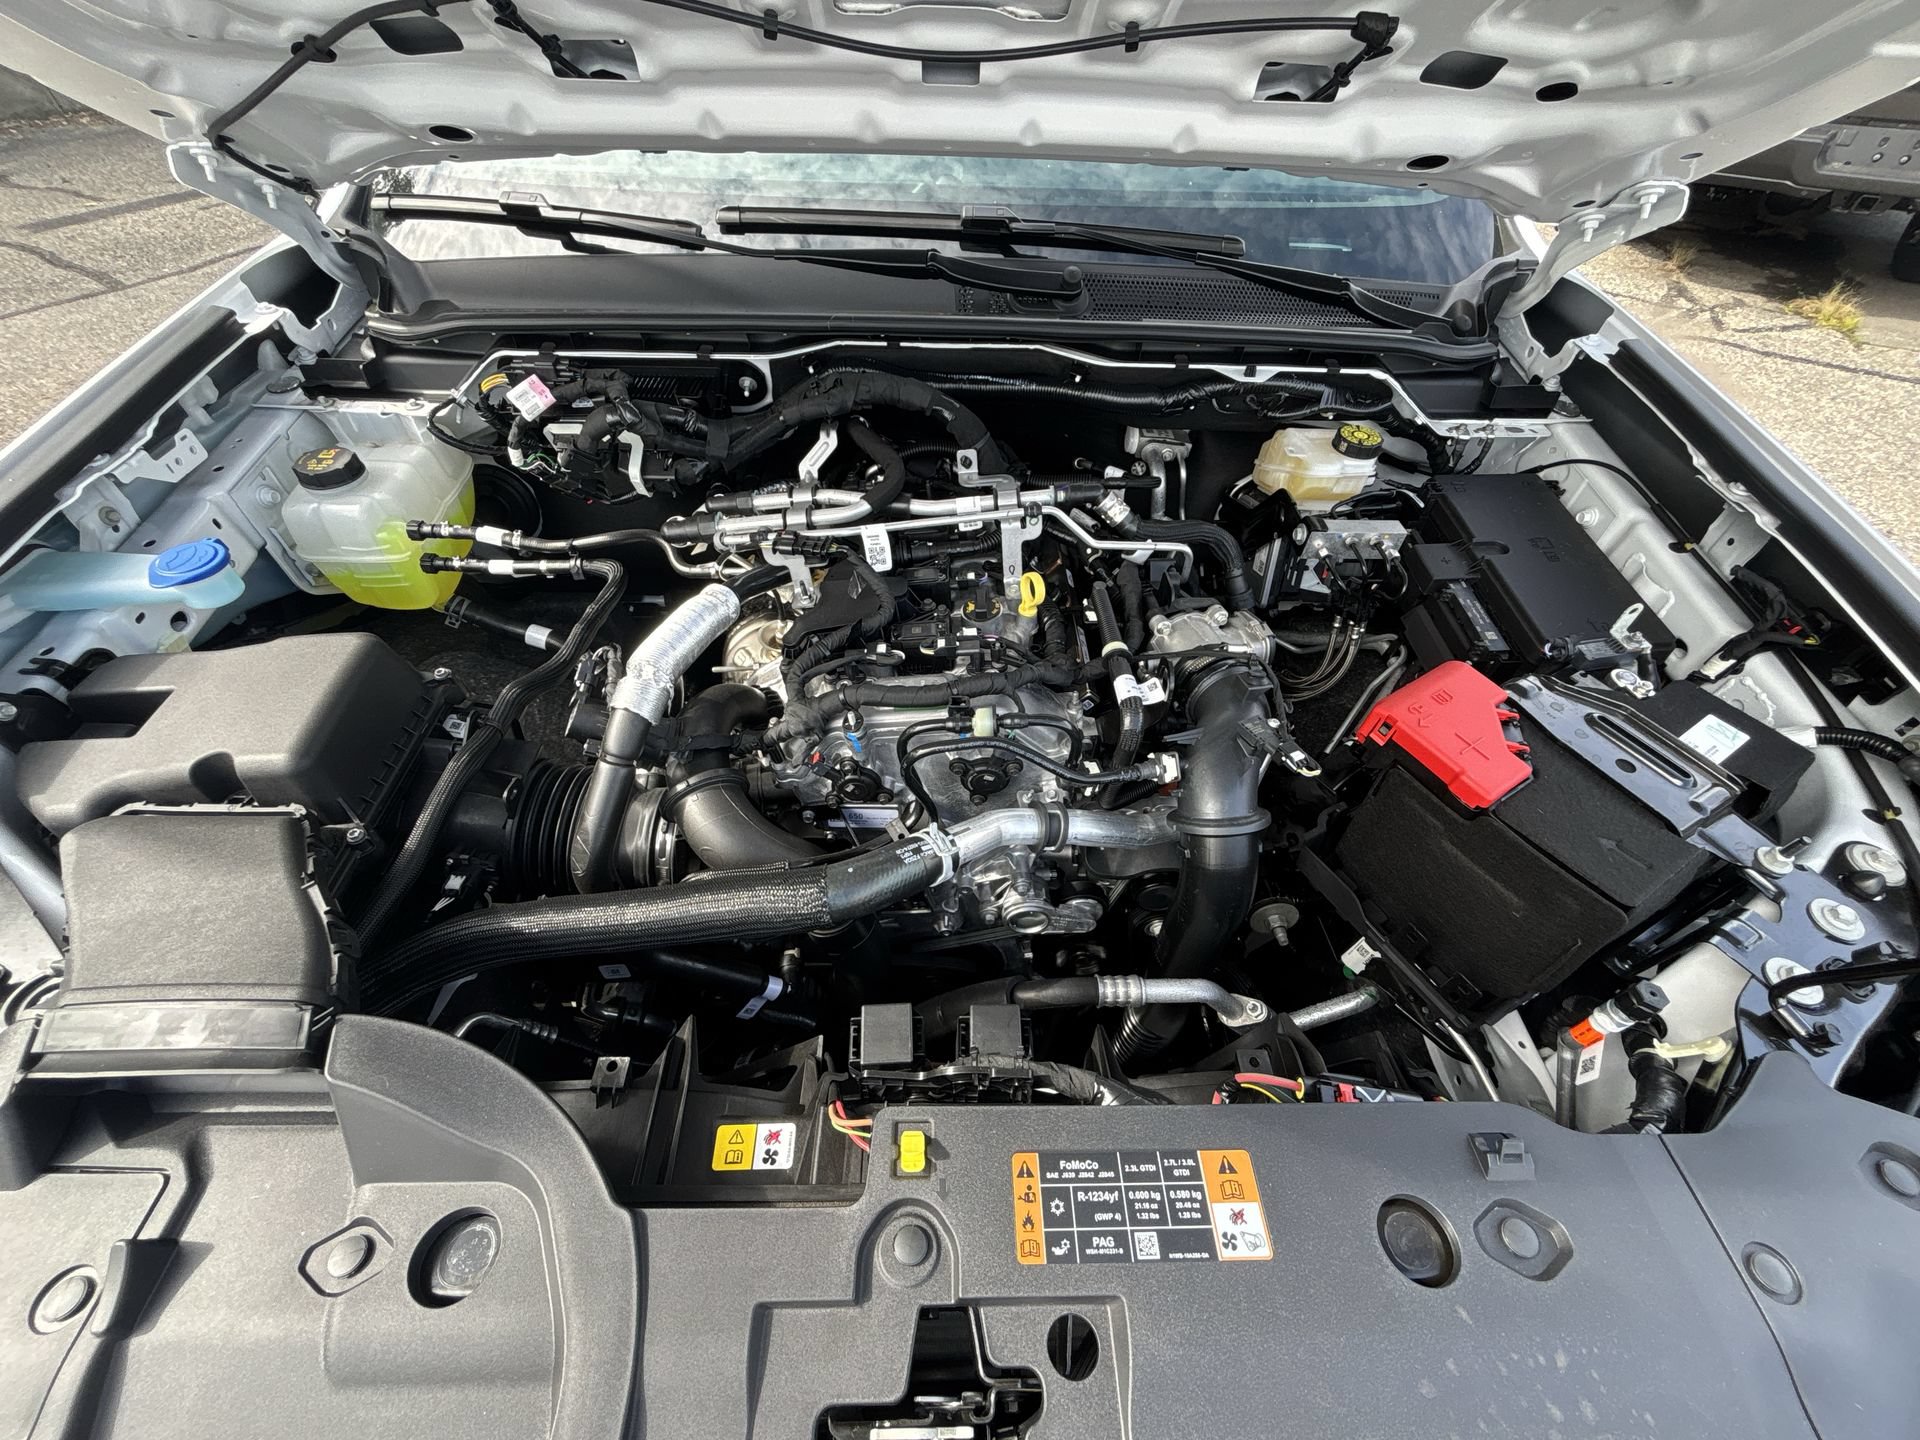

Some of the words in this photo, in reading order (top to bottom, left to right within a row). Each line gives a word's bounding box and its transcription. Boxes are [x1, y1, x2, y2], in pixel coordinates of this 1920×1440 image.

[1059, 1160, 1099, 1170] FoMoCo
[1139, 1164, 1157, 1172] GTDI
[1046, 1171, 1059, 1179] SAE
[1077, 1190, 1119, 1204] R-1234yf
[1128, 1190, 1150, 1200] 0.600
[1150, 1190, 1161, 1201] kg
[1169, 1190, 1190, 1199] 0.580
[1191, 1190, 1202, 1200] kg
[1094, 1212, 1114, 1222] (GWP
[1114, 1212, 1122, 1222] 4)
[1136, 1212, 1149, 1220] 1.32
[1149, 1212, 1160, 1220] lbs
[1191, 1211, 1202, 1219] lbs
[1092, 1236, 1115, 1248] PAG
